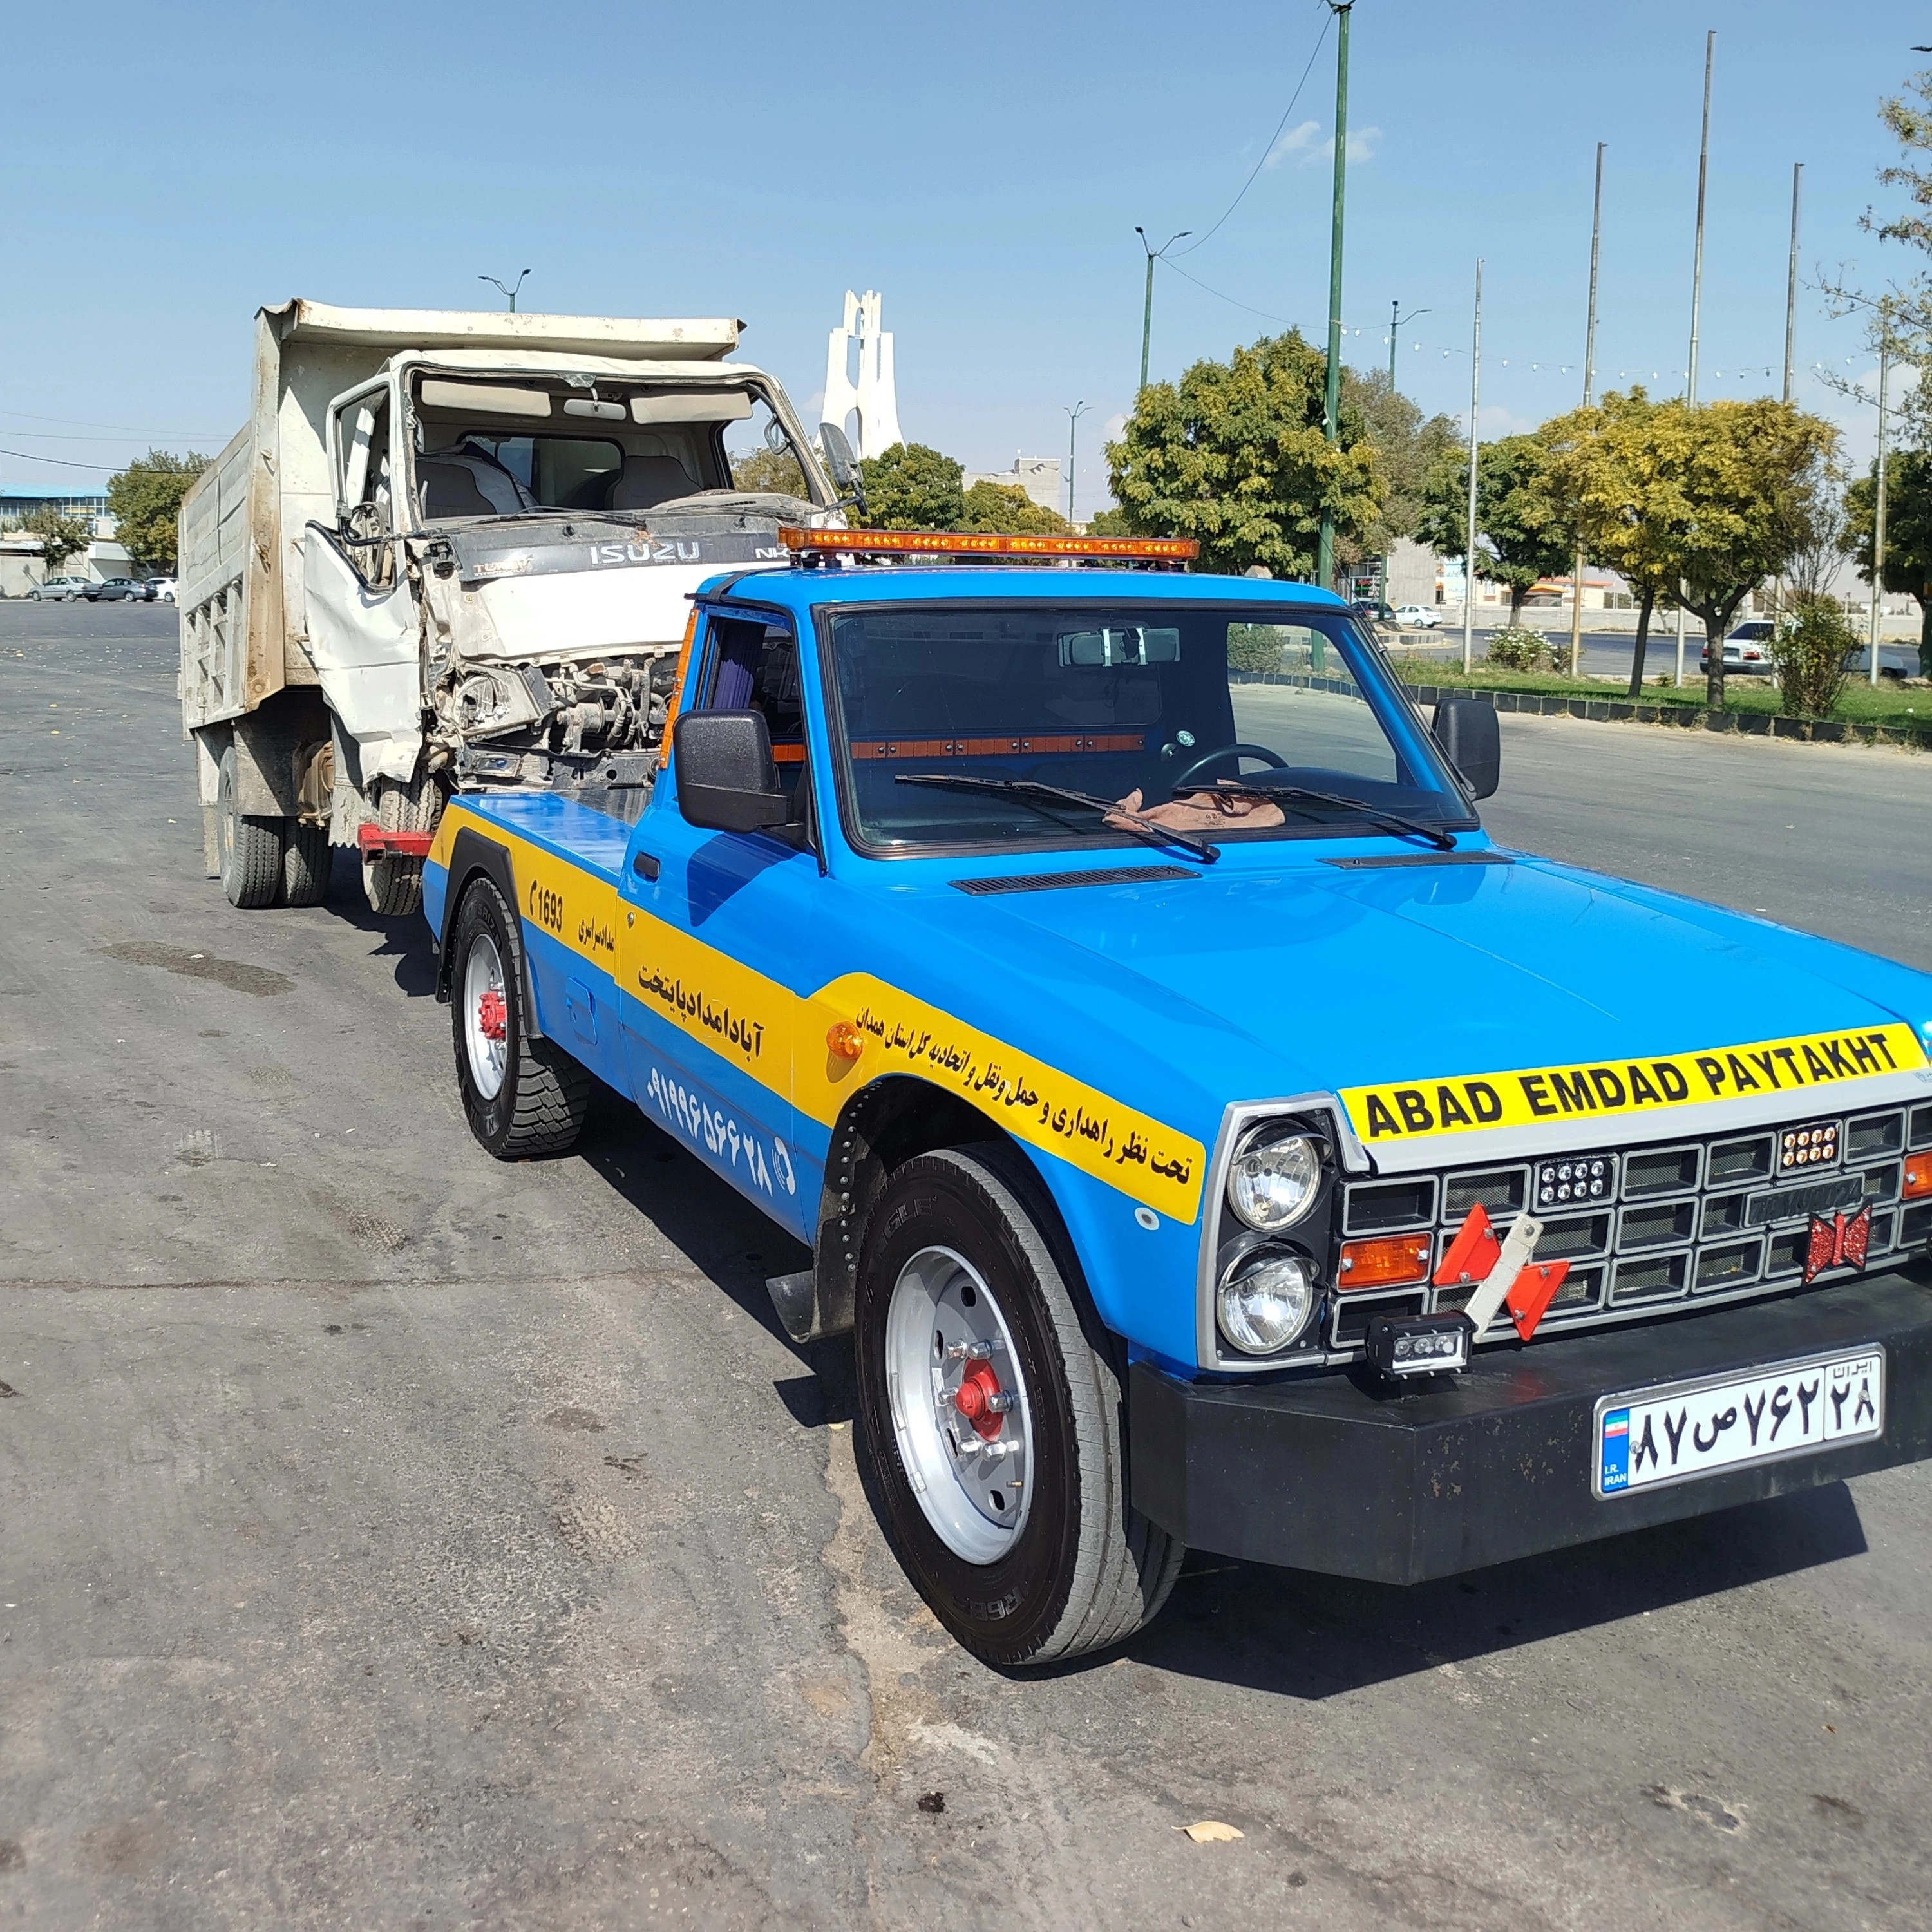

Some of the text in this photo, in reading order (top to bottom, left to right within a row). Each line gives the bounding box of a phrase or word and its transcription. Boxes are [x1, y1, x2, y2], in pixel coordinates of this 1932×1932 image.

[591, 542, 700, 565] ISUZU
[538, 886, 563, 933] 1693
[856, 1007, 884, 1037] همدان
[885, 1021, 914, 1050] استان
[929, 1043, 971, 1074] اتحادیه
[963, 1066, 976, 1086] و
[1005, 1076, 1039, 1106] حمل
[1366, 1033, 1897, 1137] ABAD EMDAD PAYTAKHT
[1037, 1101, 1050, 1124] و
[1052, 1106, 1113, 1158] راهداری
[1115, 1130, 1148, 1164] نظر
[1151, 1150, 1193, 1184] تحت
[1833, 1361, 1872, 1379] ایران
[1830, 1378, 1875, 1430] ۲۸
[1604, 1473, 1627, 1486] IRAN
[1605, 1464, 1619, 1475] I.R.
